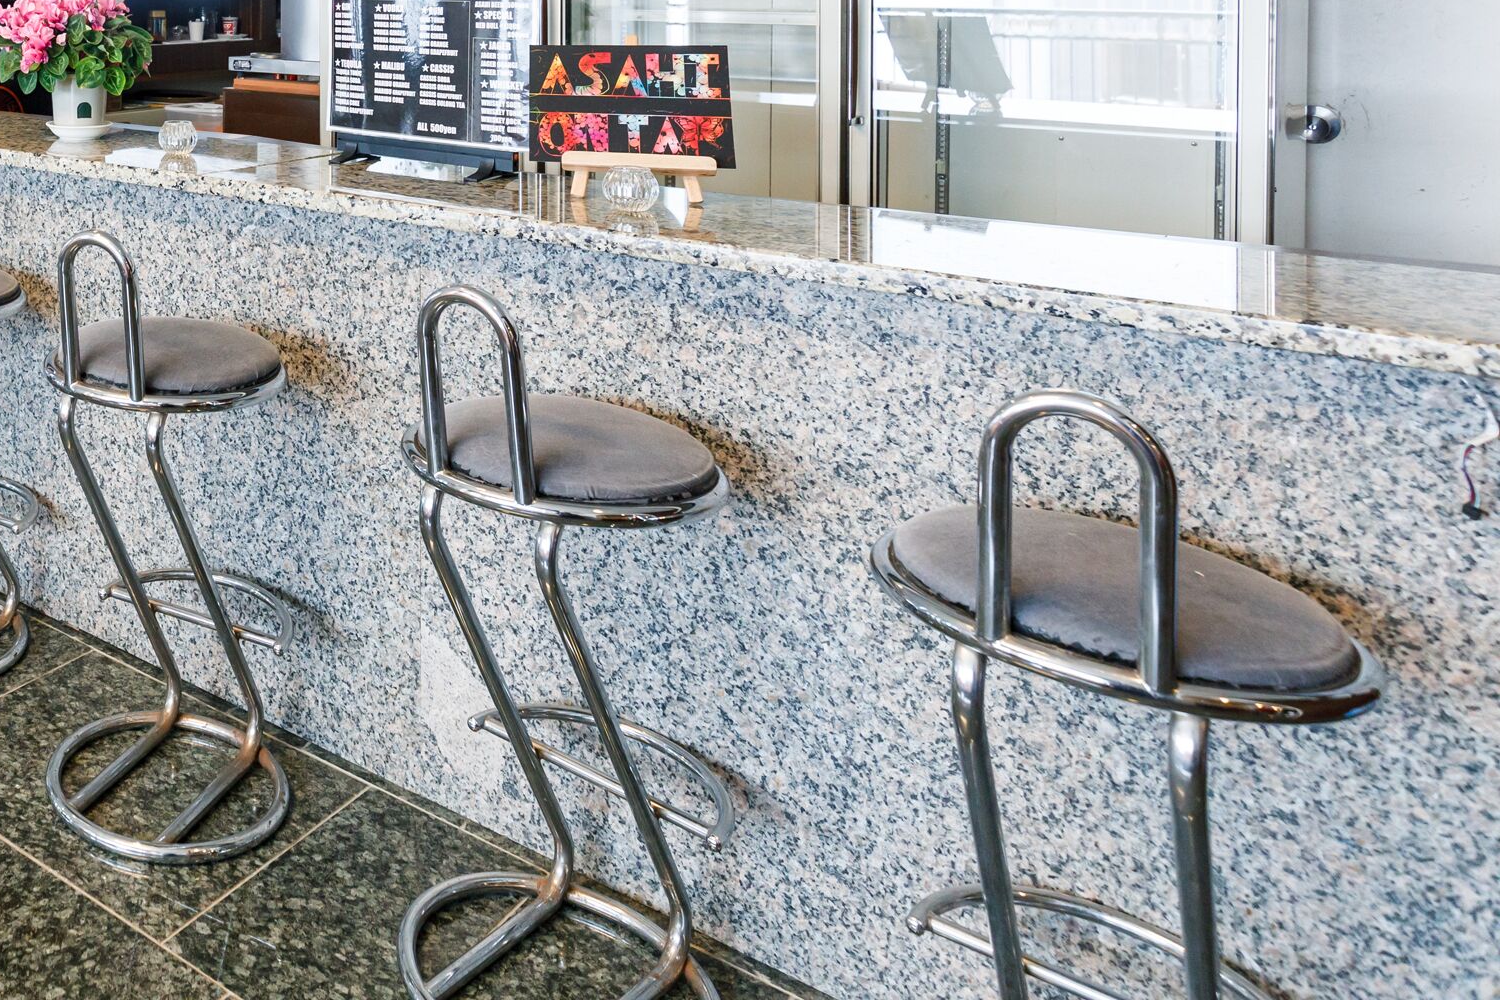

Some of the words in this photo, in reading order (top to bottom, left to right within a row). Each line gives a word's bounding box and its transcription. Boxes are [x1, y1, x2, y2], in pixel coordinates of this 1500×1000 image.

[383, 4, 404, 12] VODKA
[489, 42, 511, 50] JAGER
[341, 59, 362, 69] TEQUILA
[381, 61, 405, 71] MALIBU
[430, 64, 454, 73] CASSIS
[539, 52, 721, 98] ASAHI
[490, 80, 524, 90] WHISKEY
[417, 122, 428, 131] ALL
[430, 123, 457, 134] 500yen
[538, 112, 609, 156] ON
[618, 115, 724, 156] TAP
